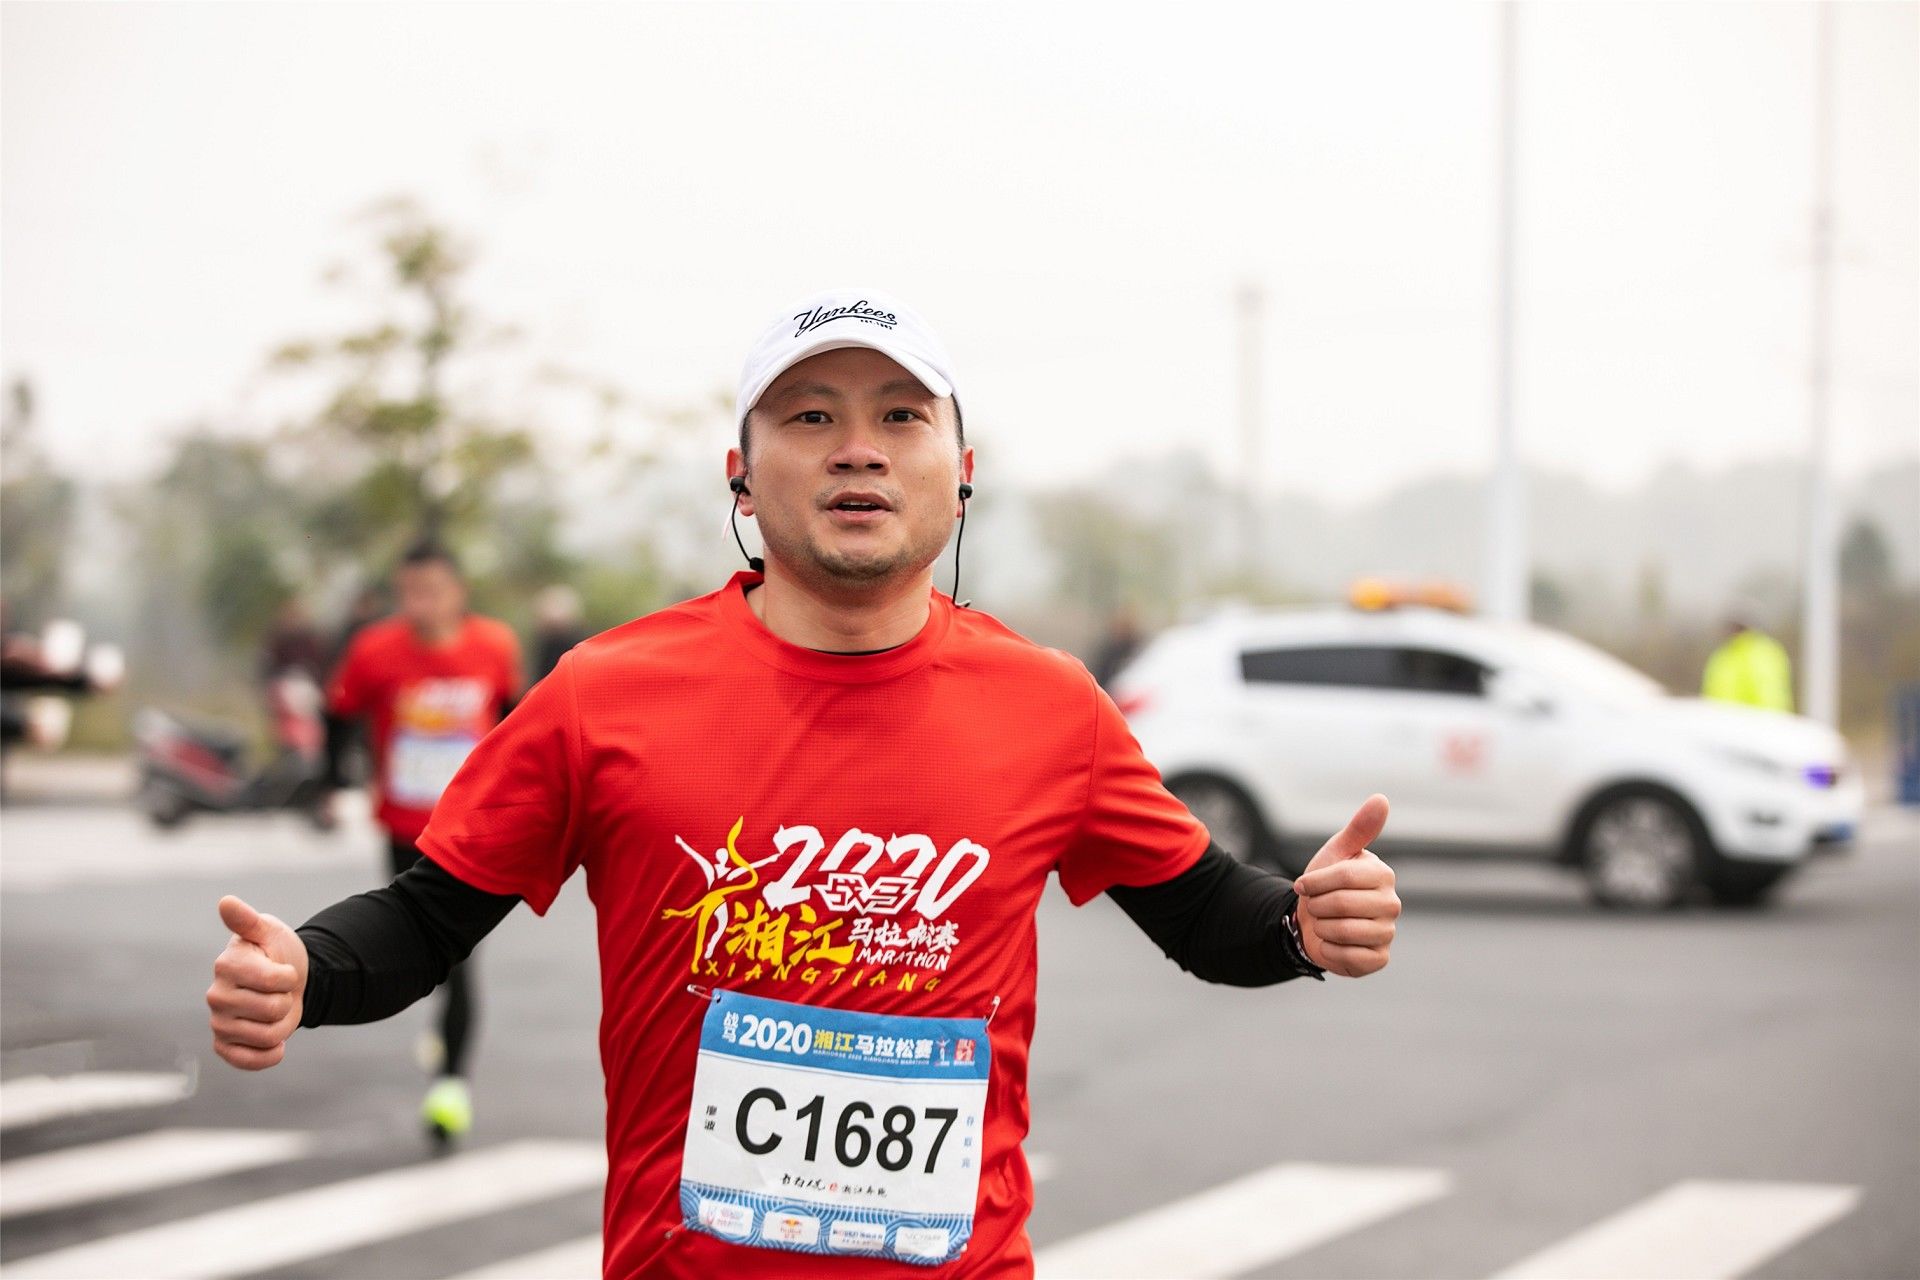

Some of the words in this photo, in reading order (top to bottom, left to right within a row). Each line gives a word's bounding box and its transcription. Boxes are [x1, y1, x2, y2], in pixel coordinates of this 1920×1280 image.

[794, 300, 897, 337] Yankees
[763, 824, 990, 920] 2020
[725, 899, 856, 966] 湘江
[848, 917, 960, 954] 马拉松赛
[856, 949, 950, 971] MARATHON
[739, 1014, 813, 1055] 2020
[735, 1087, 959, 1174] C1687
